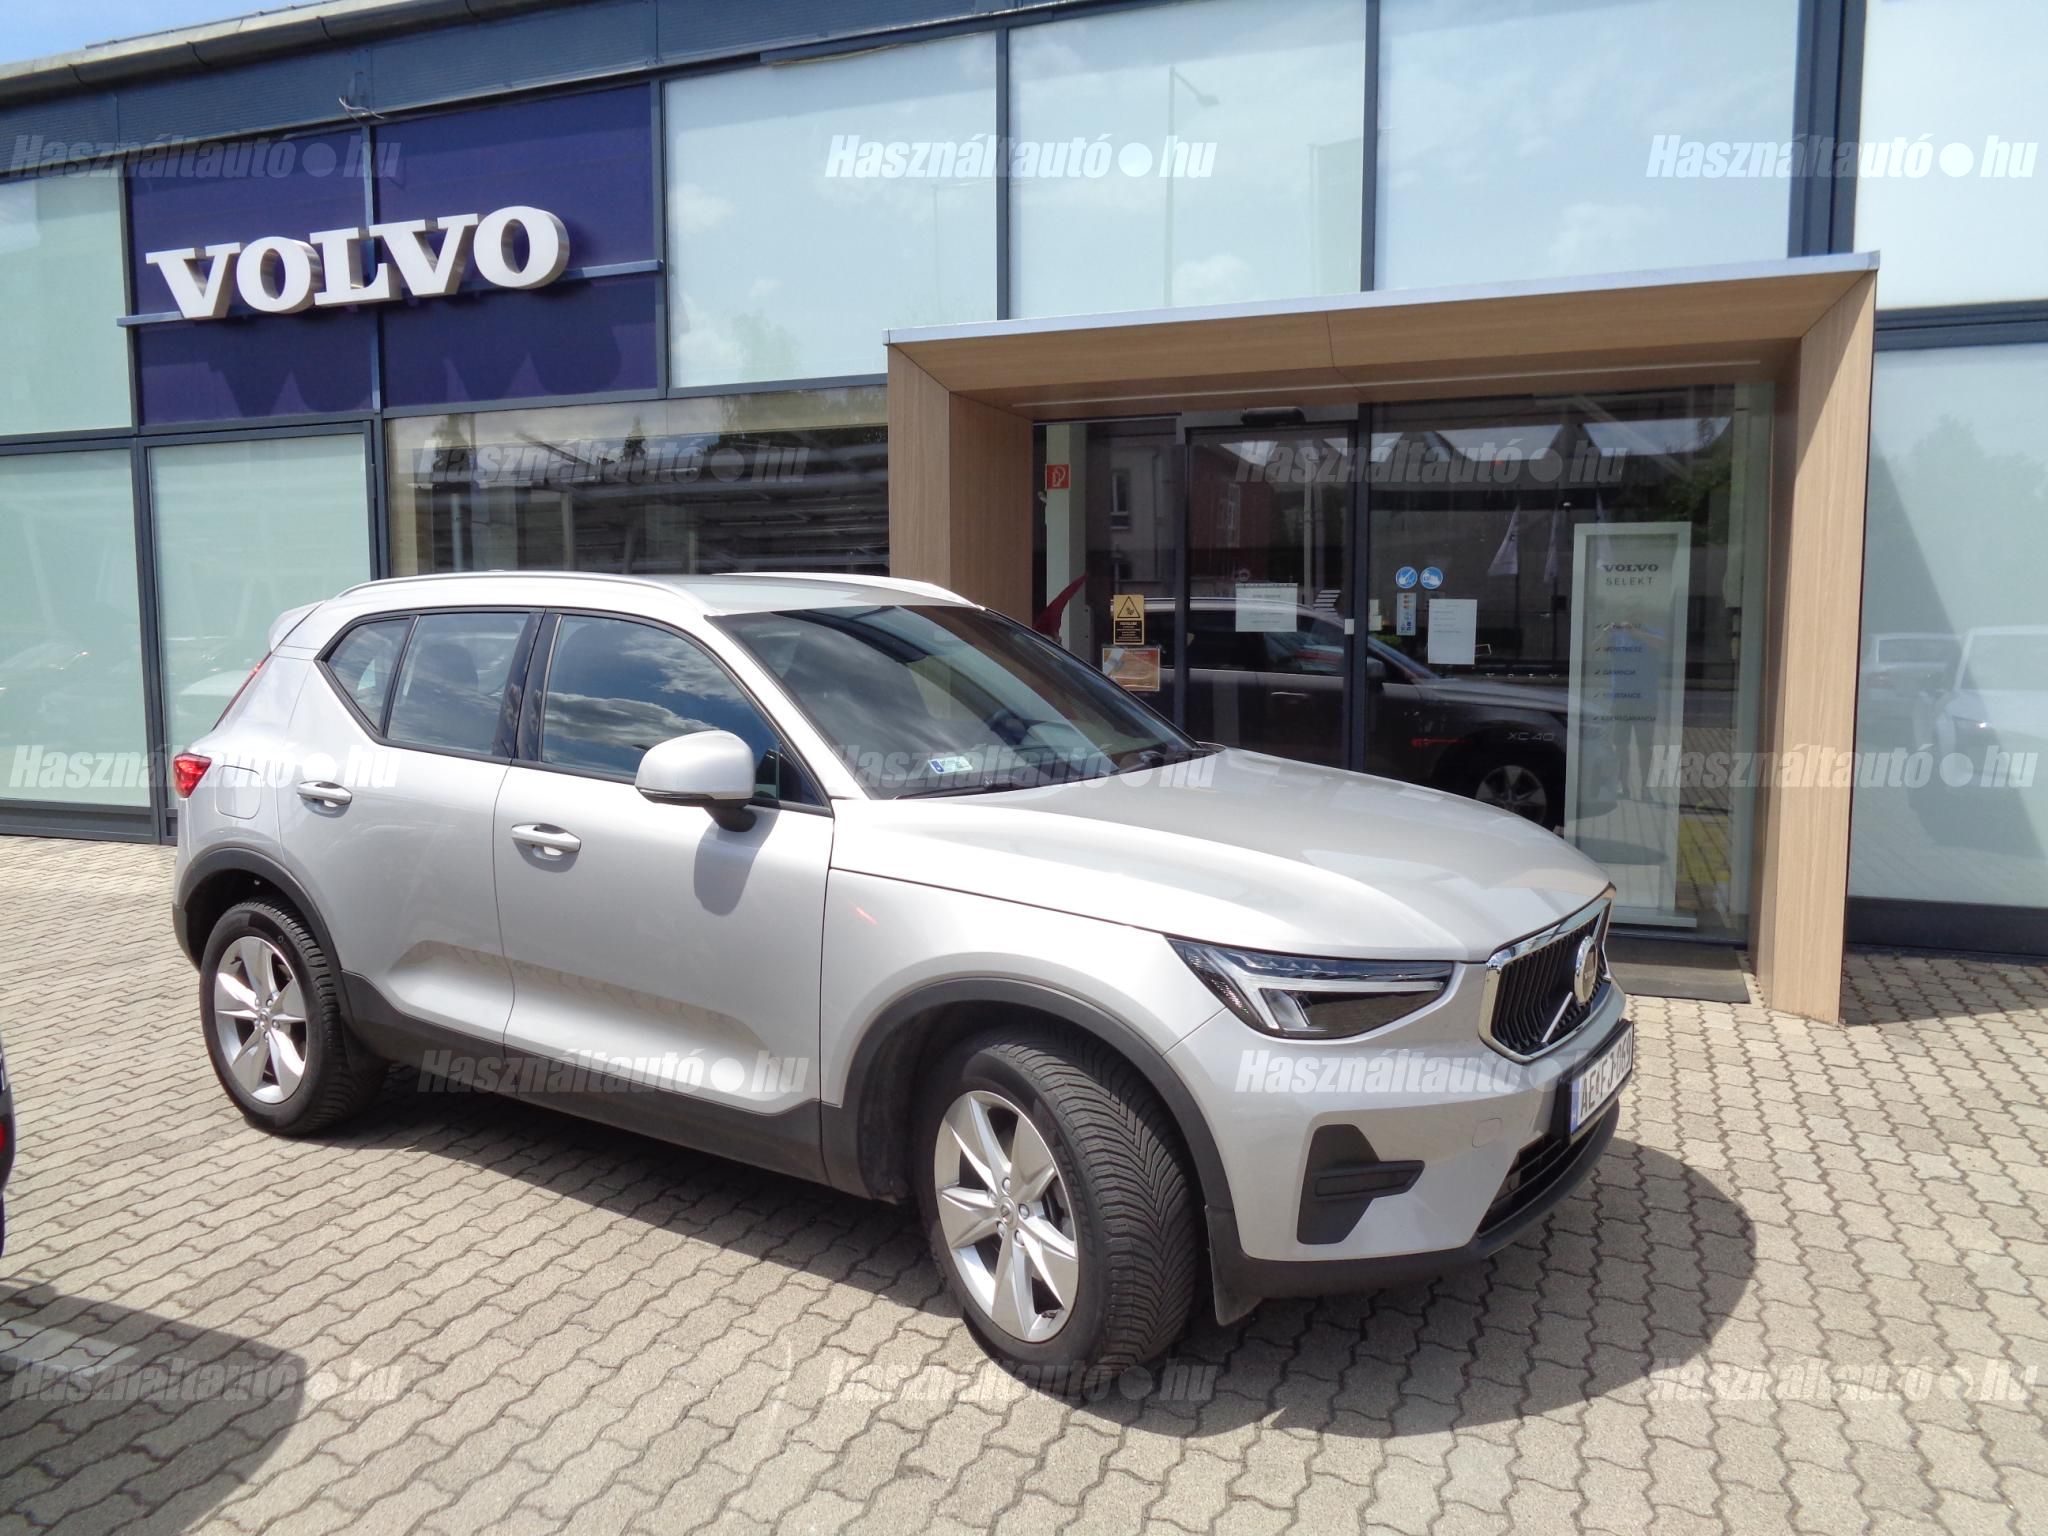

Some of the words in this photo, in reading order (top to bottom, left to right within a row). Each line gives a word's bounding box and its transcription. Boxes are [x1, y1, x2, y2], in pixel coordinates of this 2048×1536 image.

[146, 205, 570, 320] VOLVO
[1602, 563, 1659, 572] VOLVO
[1605, 577, 1653, 586] SELEKT
